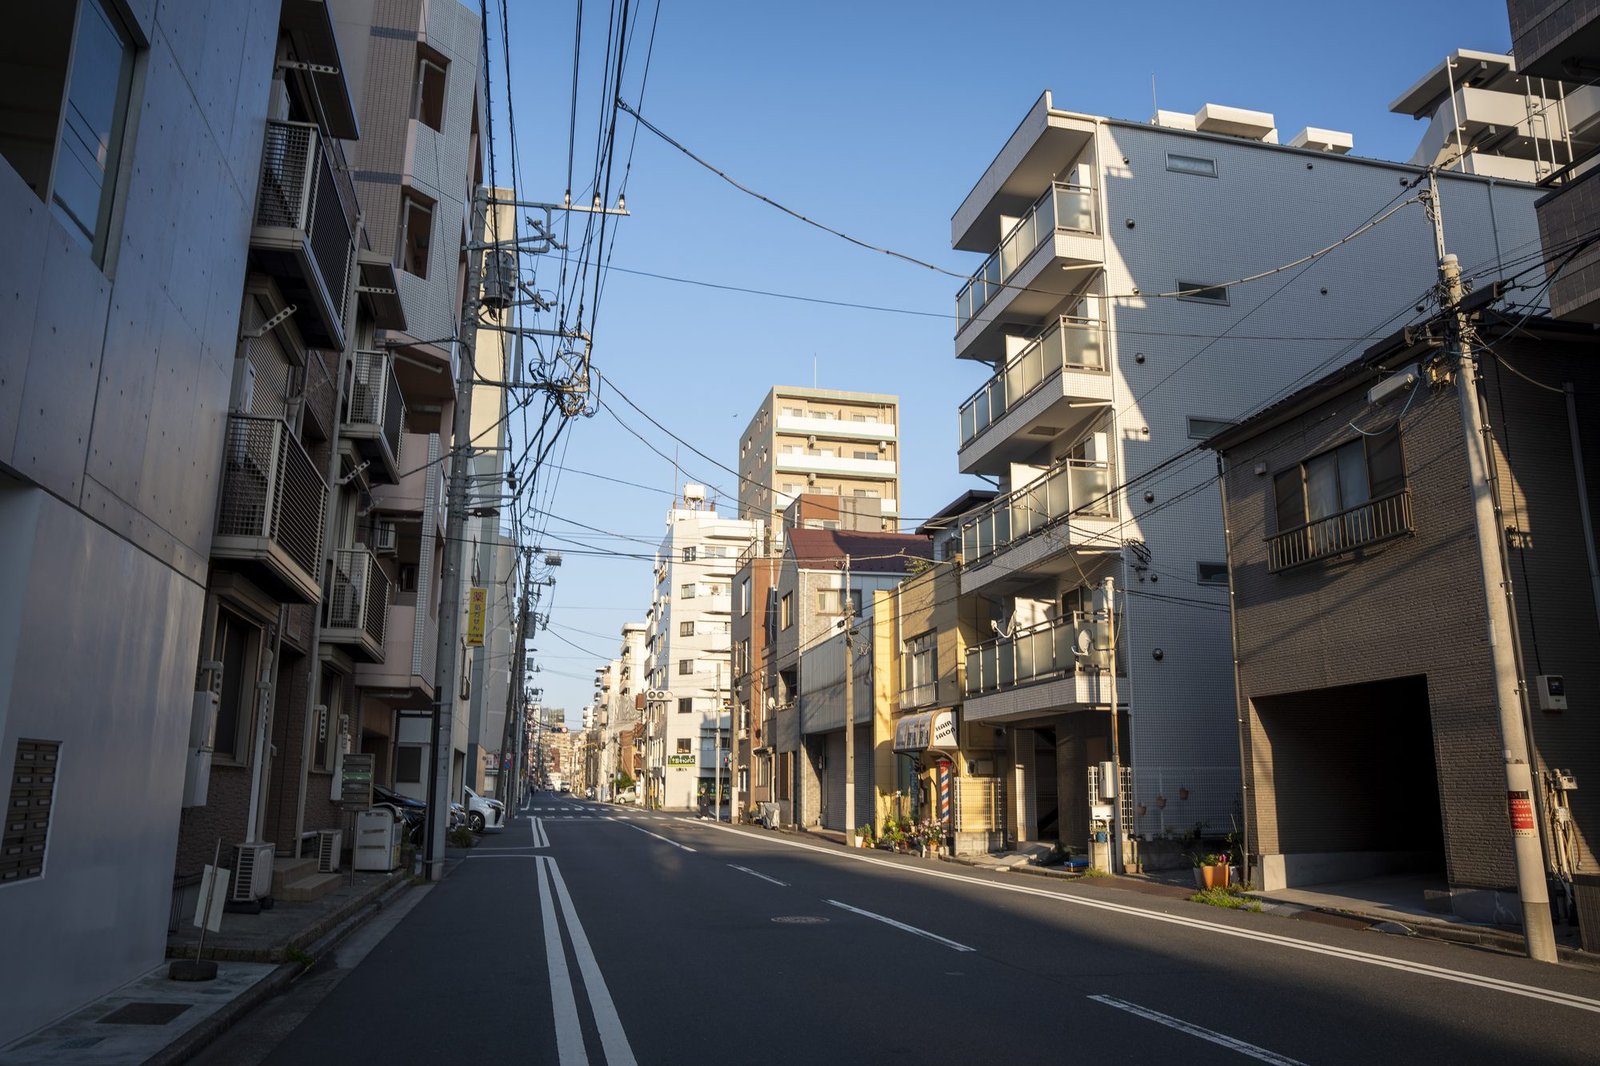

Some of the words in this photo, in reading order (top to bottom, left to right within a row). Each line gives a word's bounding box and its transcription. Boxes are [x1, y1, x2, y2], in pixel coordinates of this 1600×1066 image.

[473, 591, 483, 603] 薬
[935, 720, 953, 732] HAIR
[935, 727, 956, 740] SALON
